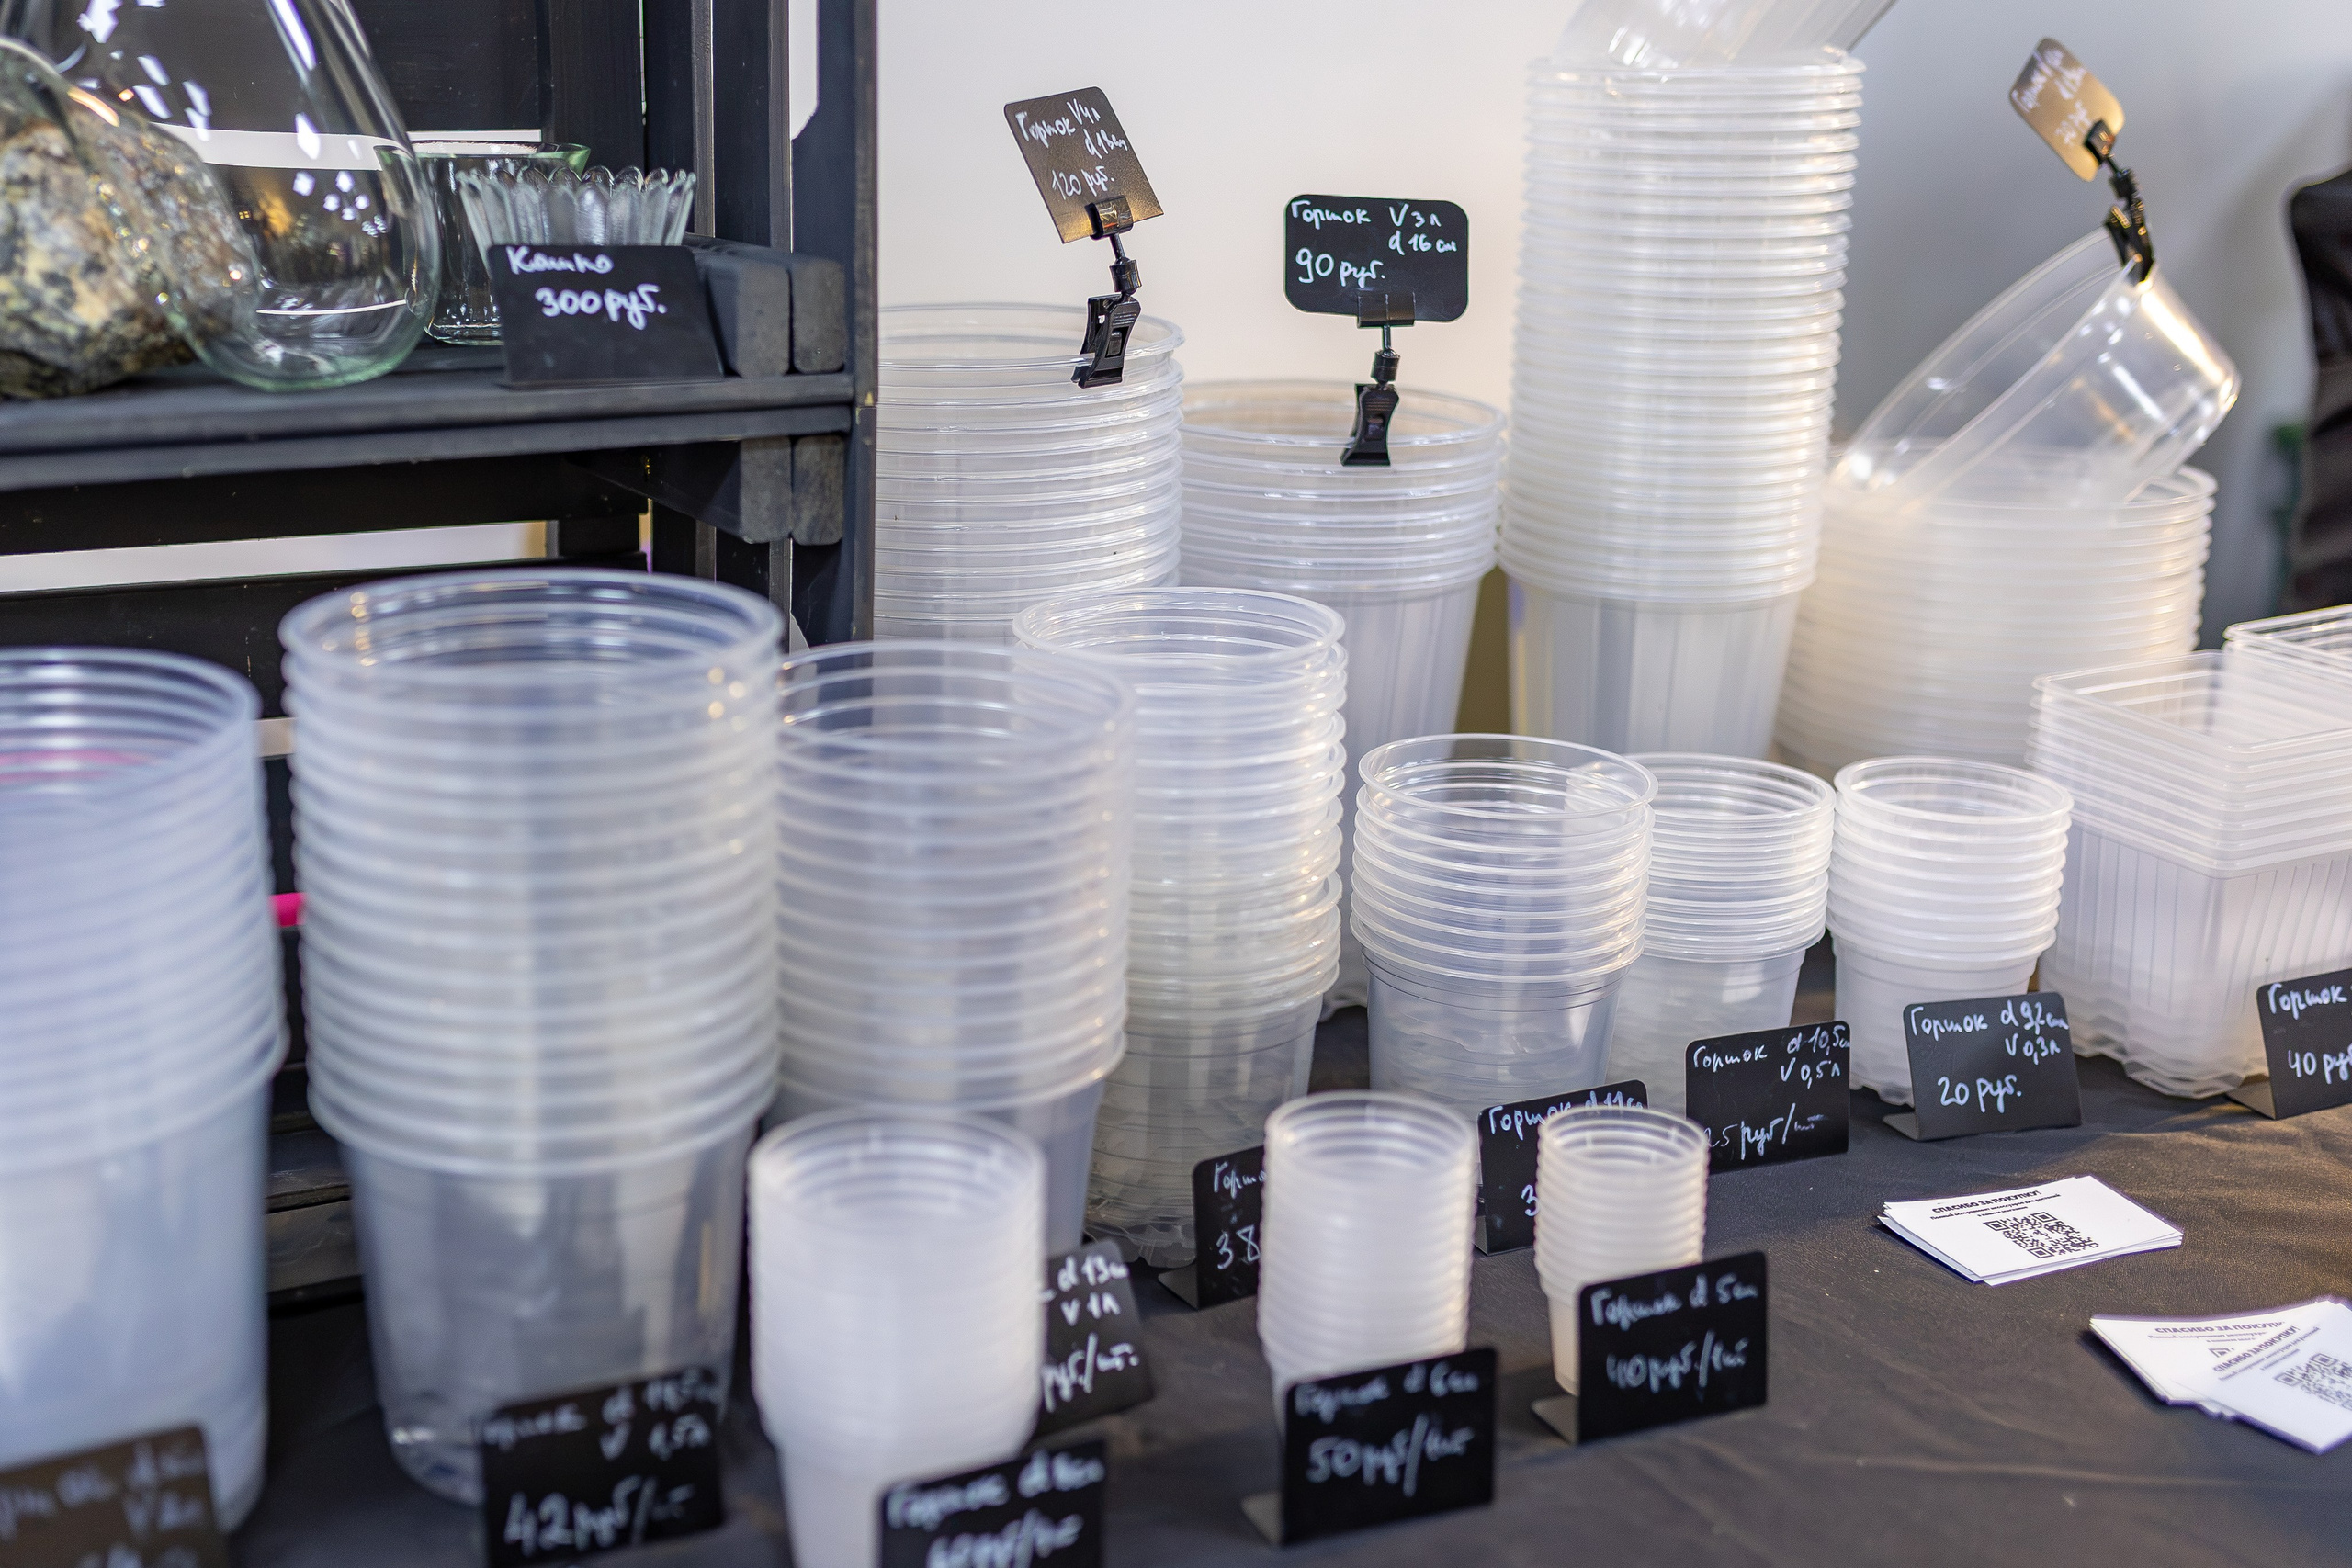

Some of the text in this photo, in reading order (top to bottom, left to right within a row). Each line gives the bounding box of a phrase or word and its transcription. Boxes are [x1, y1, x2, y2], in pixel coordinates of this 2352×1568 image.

[1015, 111, 1076, 148] Горшок
[1052, 169, 1082, 200] 120
[1291, 200, 1371, 230] Горшок
[1295, 247, 1334, 284] 90
[2267, 982, 2347, 1020] Горшок
[1911, 1007, 1988, 1041] Горшок
[1693, 1045, 1768, 1072] Горшок
[2288, 1049, 2317, 1078] 40
[1938, 1076, 1970, 1106] 20
[1213, 1161, 1266, 1199] Горшо
[1521, 1184, 1541, 1216] 3
[1932, 1201, 1977, 1213] СПАСИБО
[1216, 1224, 1261, 1269] 38
